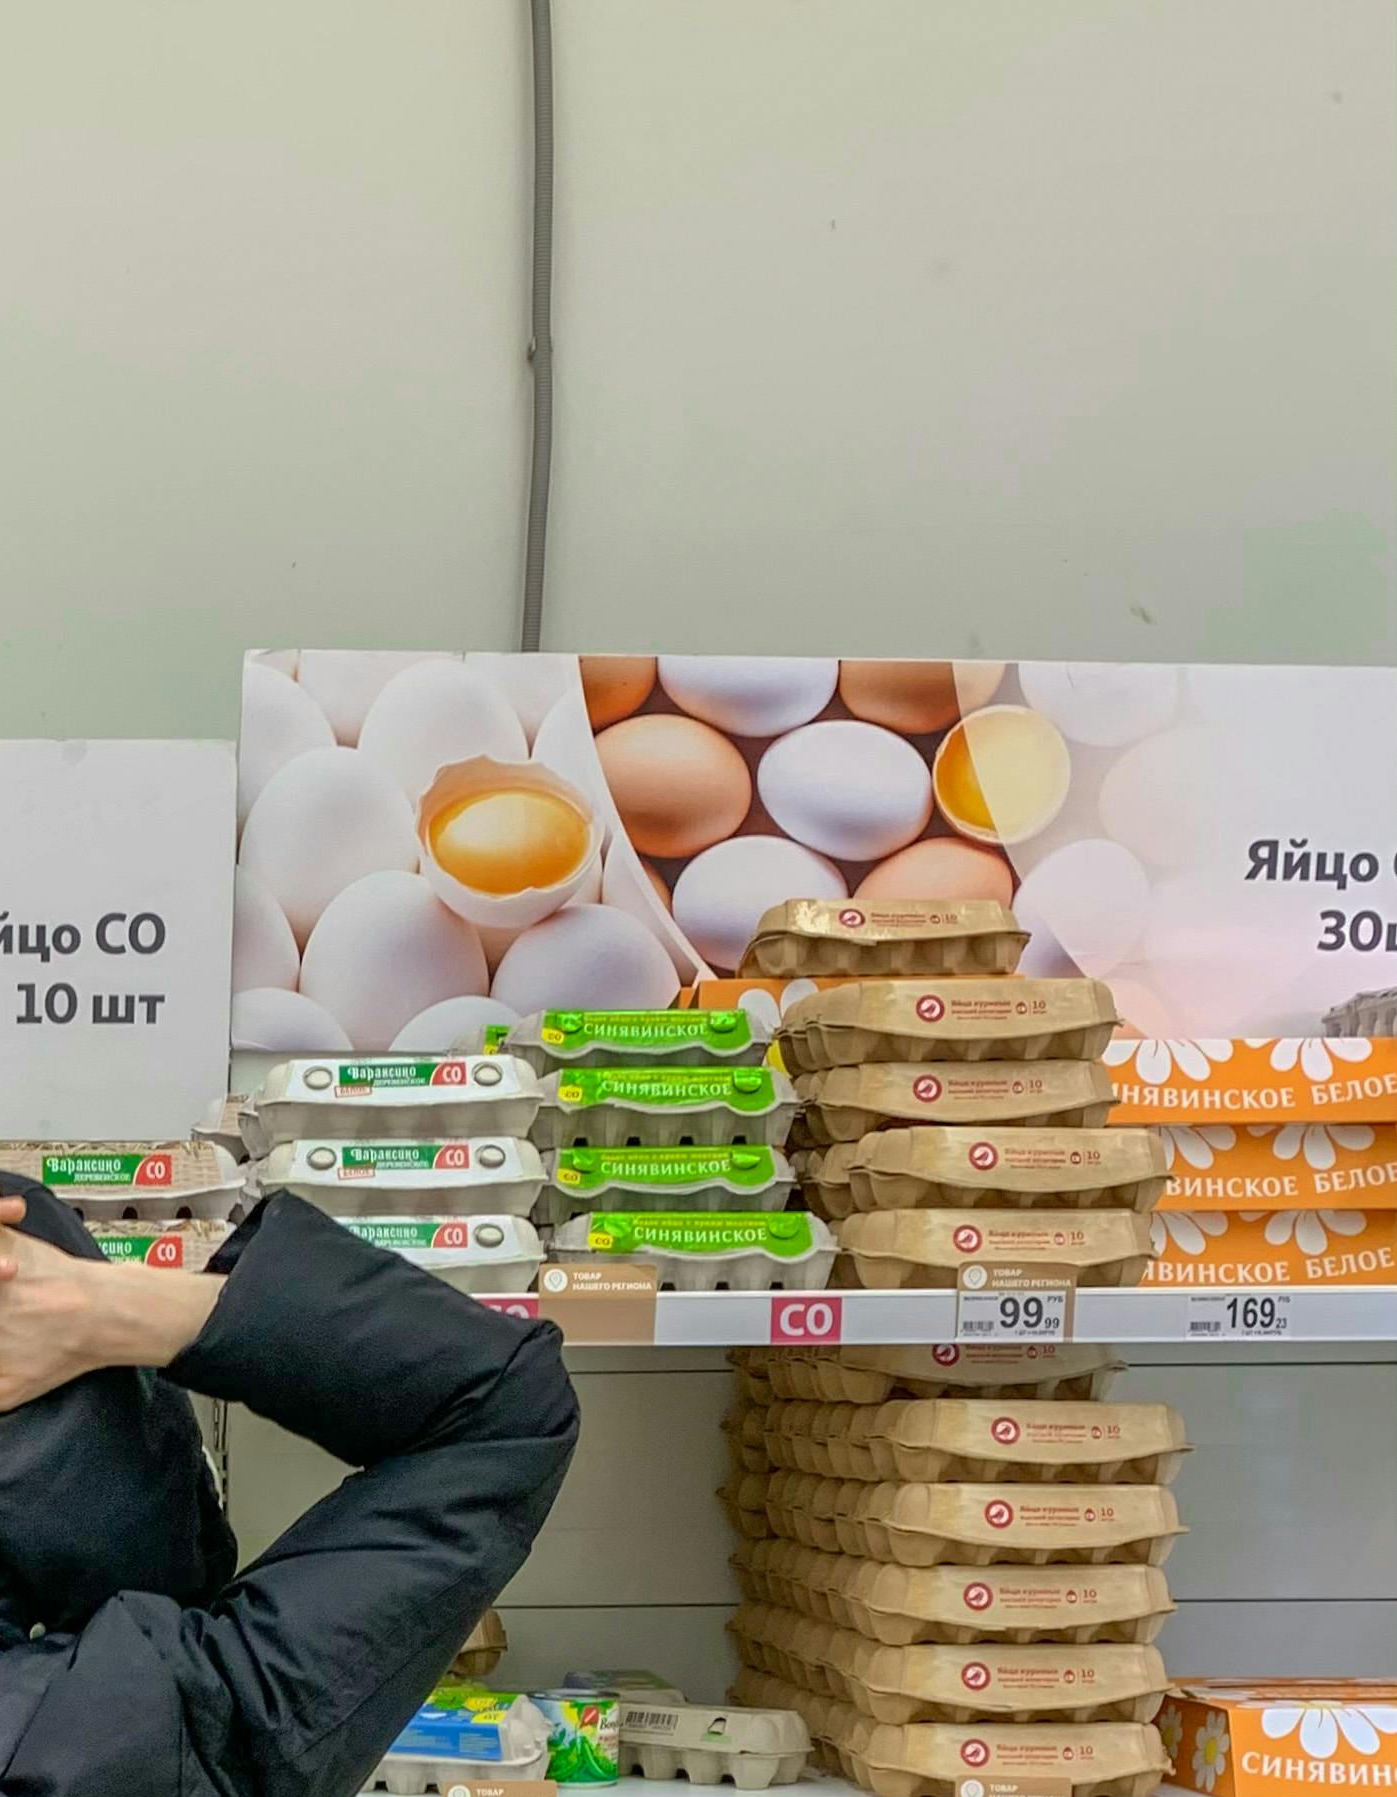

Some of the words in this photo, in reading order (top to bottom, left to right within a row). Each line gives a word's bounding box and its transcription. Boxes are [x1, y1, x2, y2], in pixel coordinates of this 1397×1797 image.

[1244, 838, 1379, 890] Яйцо
[16, 982, 78, 1024] 10
[92, 995, 165, 1024] шт
[1311, 1073, 1397, 1105] БЕЛОЕ
[46, 1158, 121, 1174] Вараксино
[600, 1160, 730, 1176] СИНЯВИНСКОЕ
[1314, 1162, 1397, 1194] БЕЛОЕ
[634, 1225, 767, 1243] СИНЯВИНСКОЕ
[1306, 1248, 1395, 1280] БЕЛОЕ
[573, 1282, 609, 1290] НАШЕГО
[611, 1282, 652, 1290] РЕГИОНА
[992, 1279, 1029, 1287] НАШЕГО
[1031, 1279, 1071, 1287] РЕГИОНА
[1000, 1297, 1043, 1328] 99
[1044, 1318, 1059, 1329] 99
[1227, 1297, 1275, 1329] 169
[1276, 1318, 1287, 1329] 23
[1242, 1752, 1397, 1786] СИНЯВИН
